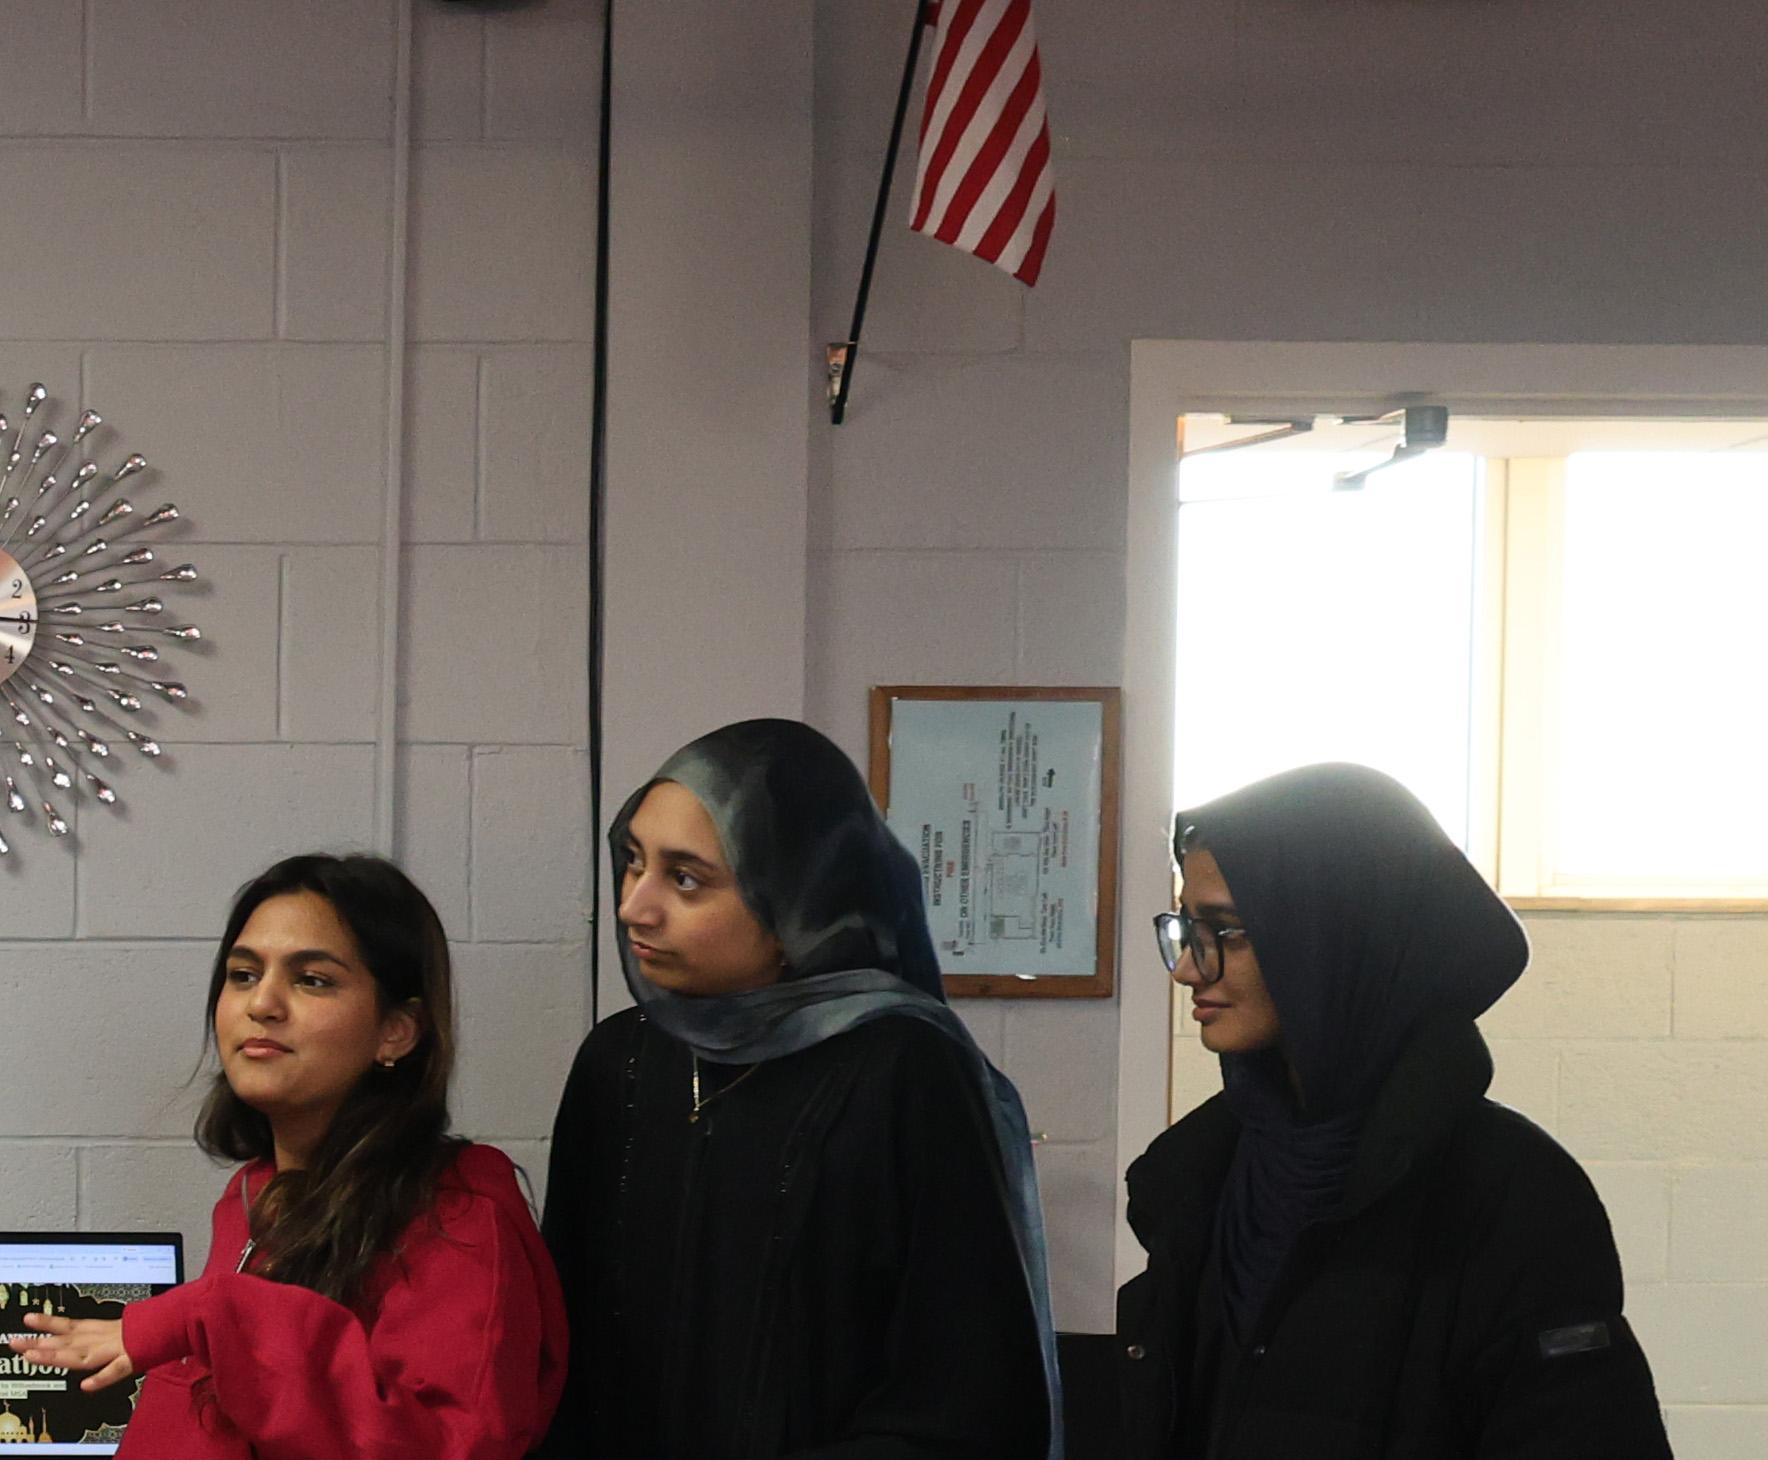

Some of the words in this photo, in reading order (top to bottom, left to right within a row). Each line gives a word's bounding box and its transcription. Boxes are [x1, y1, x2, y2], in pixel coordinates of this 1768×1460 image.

[11, 579, 22, 598] 2
[18, 611, 30, 634] 3
[4, 645, 15, 664] 4
